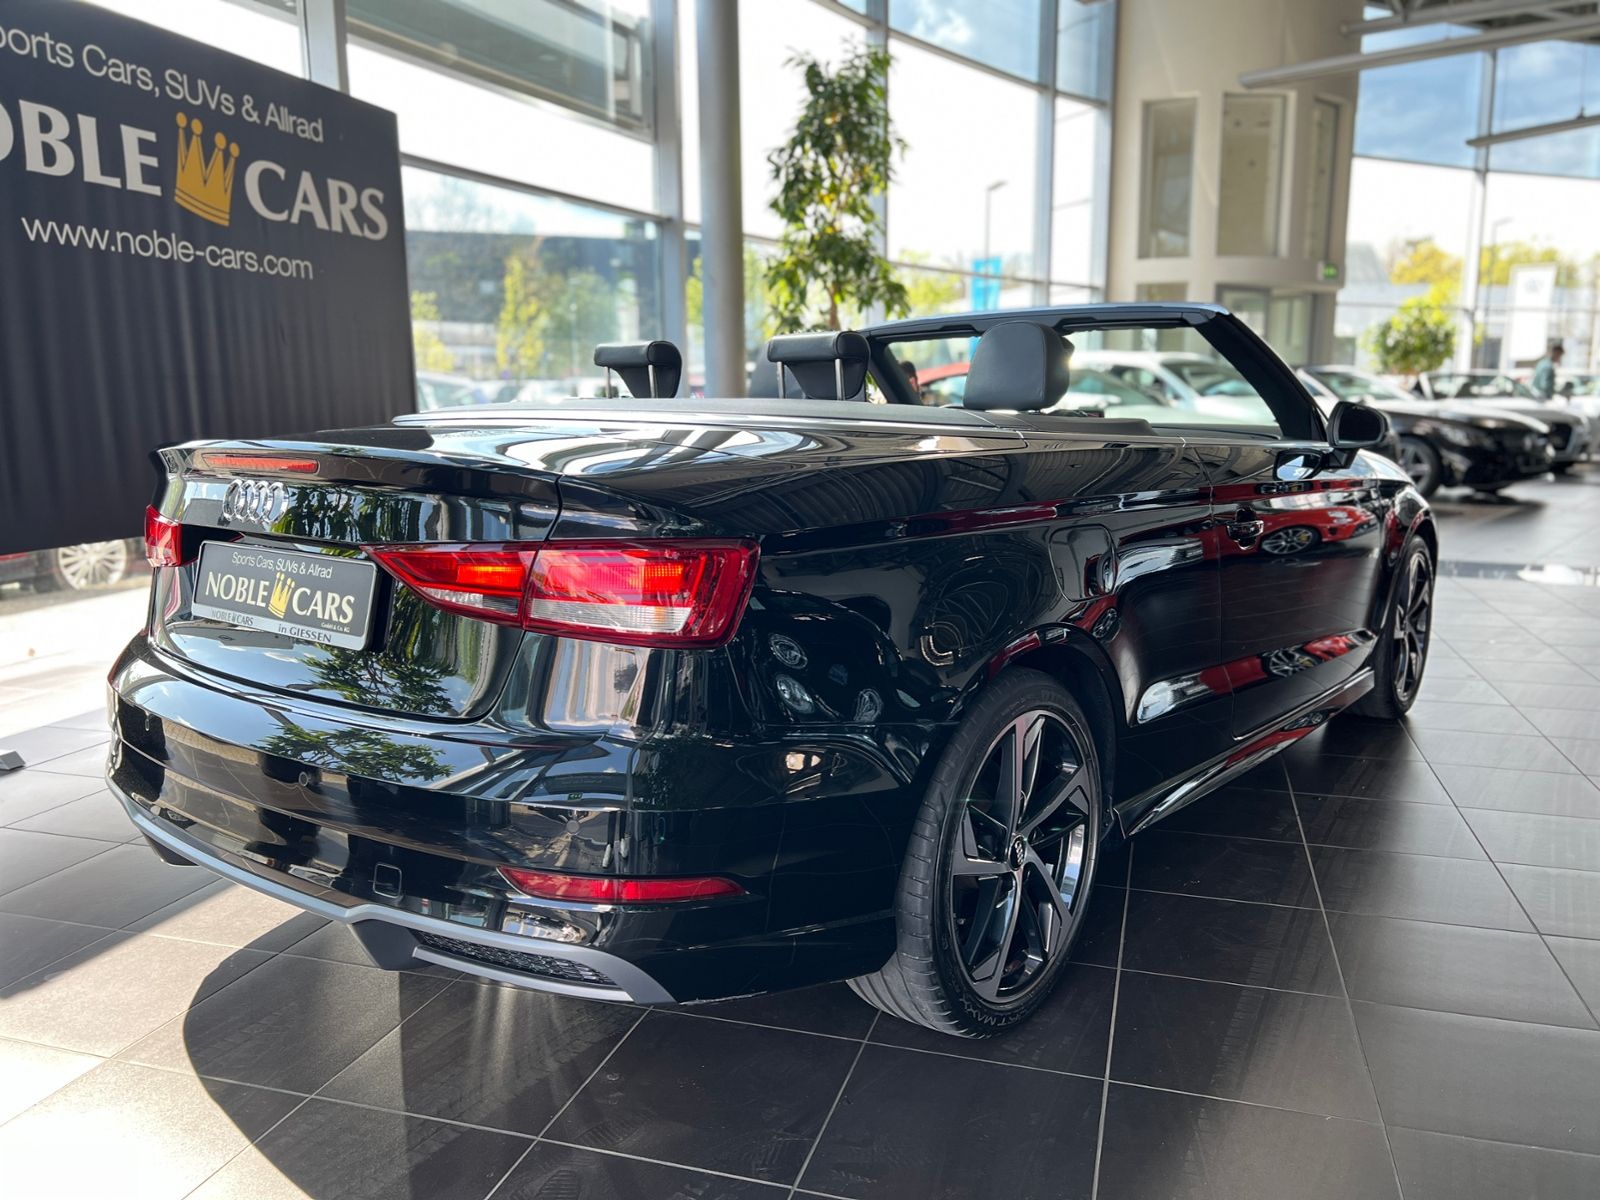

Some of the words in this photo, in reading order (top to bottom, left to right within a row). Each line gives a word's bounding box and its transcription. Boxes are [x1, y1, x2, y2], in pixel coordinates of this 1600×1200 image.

[82, 43, 161, 98] Cars,
[164, 69, 236, 116] SUVs
[242, 94, 261, 123] &
[264, 102, 324, 143] Allrad
[0, 99, 162, 197] BLE
[244, 159, 389, 241] CARS
[21, 217, 314, 280] www.noble-cars.com
[231, 551, 256, 567] Sports
[275, 558, 298, 574] SUVs
[299, 562, 306, 575] &
[307, 563, 333, 579] Allrad
[205, 571, 269, 608] NOBLE
[292, 586, 355, 624] CARS
[211, 609, 231, 622] NOBLE
[236, 614, 254, 626] CARS
[278, 623, 287, 633] in
[289, 626, 332, 643] GIESSEN
